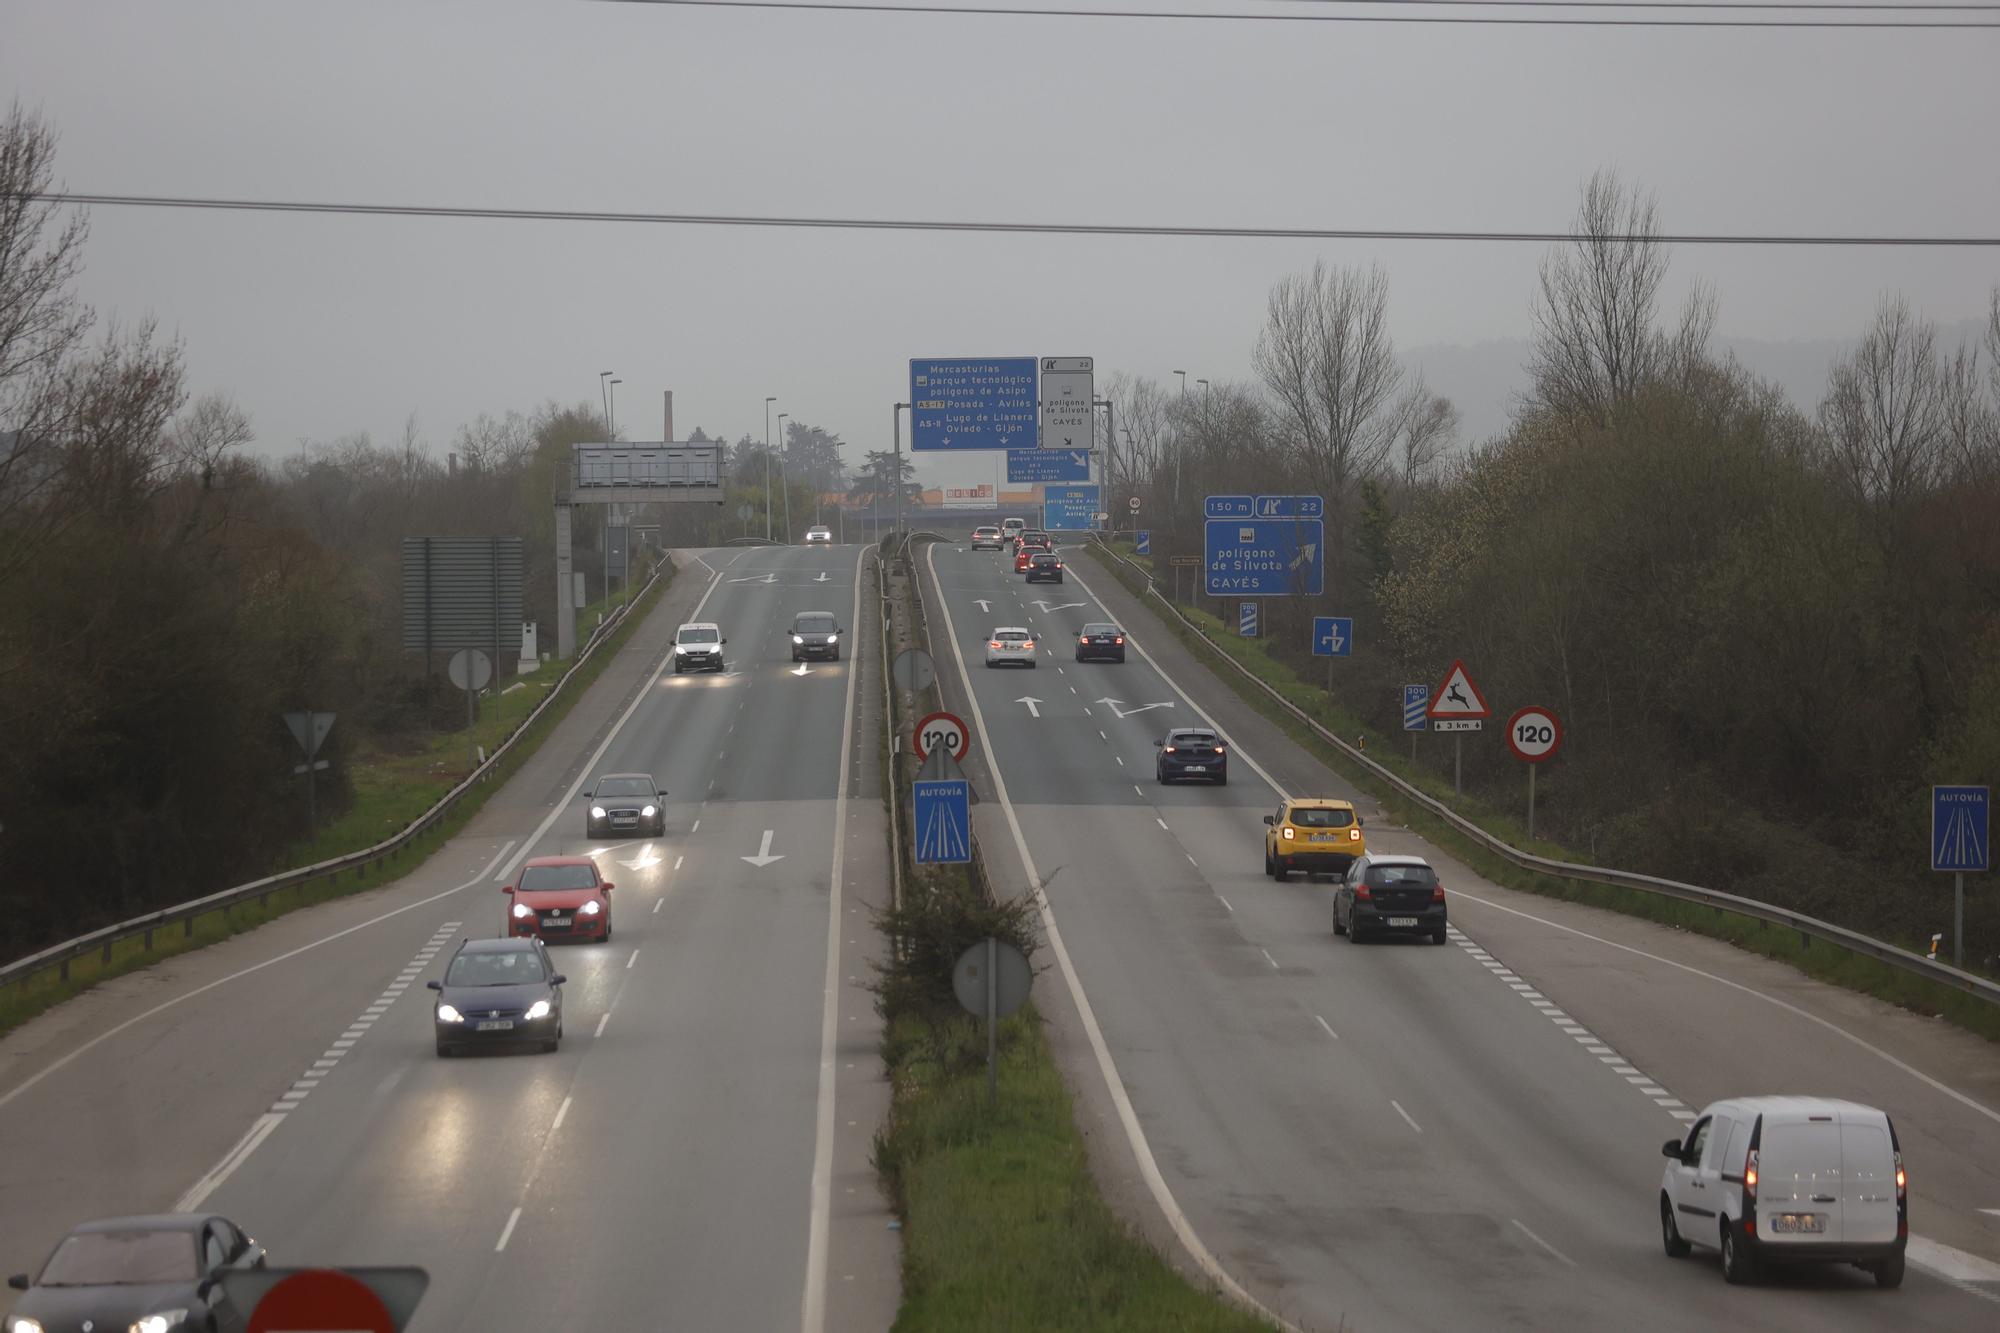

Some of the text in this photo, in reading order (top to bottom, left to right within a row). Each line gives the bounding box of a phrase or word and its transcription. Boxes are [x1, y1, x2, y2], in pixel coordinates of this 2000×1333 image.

[930, 364, 1000, 373] Mercasturias
[930, 375, 1032, 387] parque tecnológico
[980, 387, 992, 395] de
[997, 386, 1026, 396] Asipo
[947, 400, 984, 409] Posada
[998, 399, 1031, 408] Avilés
[946, 412, 1033, 424] Lugo de Llanera
[946, 424, 981, 433] Oviedo
[995, 423, 1023, 434] Gijón
[1210, 502, 1247, 511] 150 m
[1302, 502, 1317, 511] 22
[1218, 547, 1276, 560] polígono
[1212, 560, 1282, 570] de Silvota
[1211, 576, 1260, 588] CAYÉS
[1407, 687, 1425, 695] 300
[1517, 725, 1552, 743] 120
[920, 786, 963, 797] AUTOVÍA
[1939, 792, 1983, 802] AUTOVÍA
